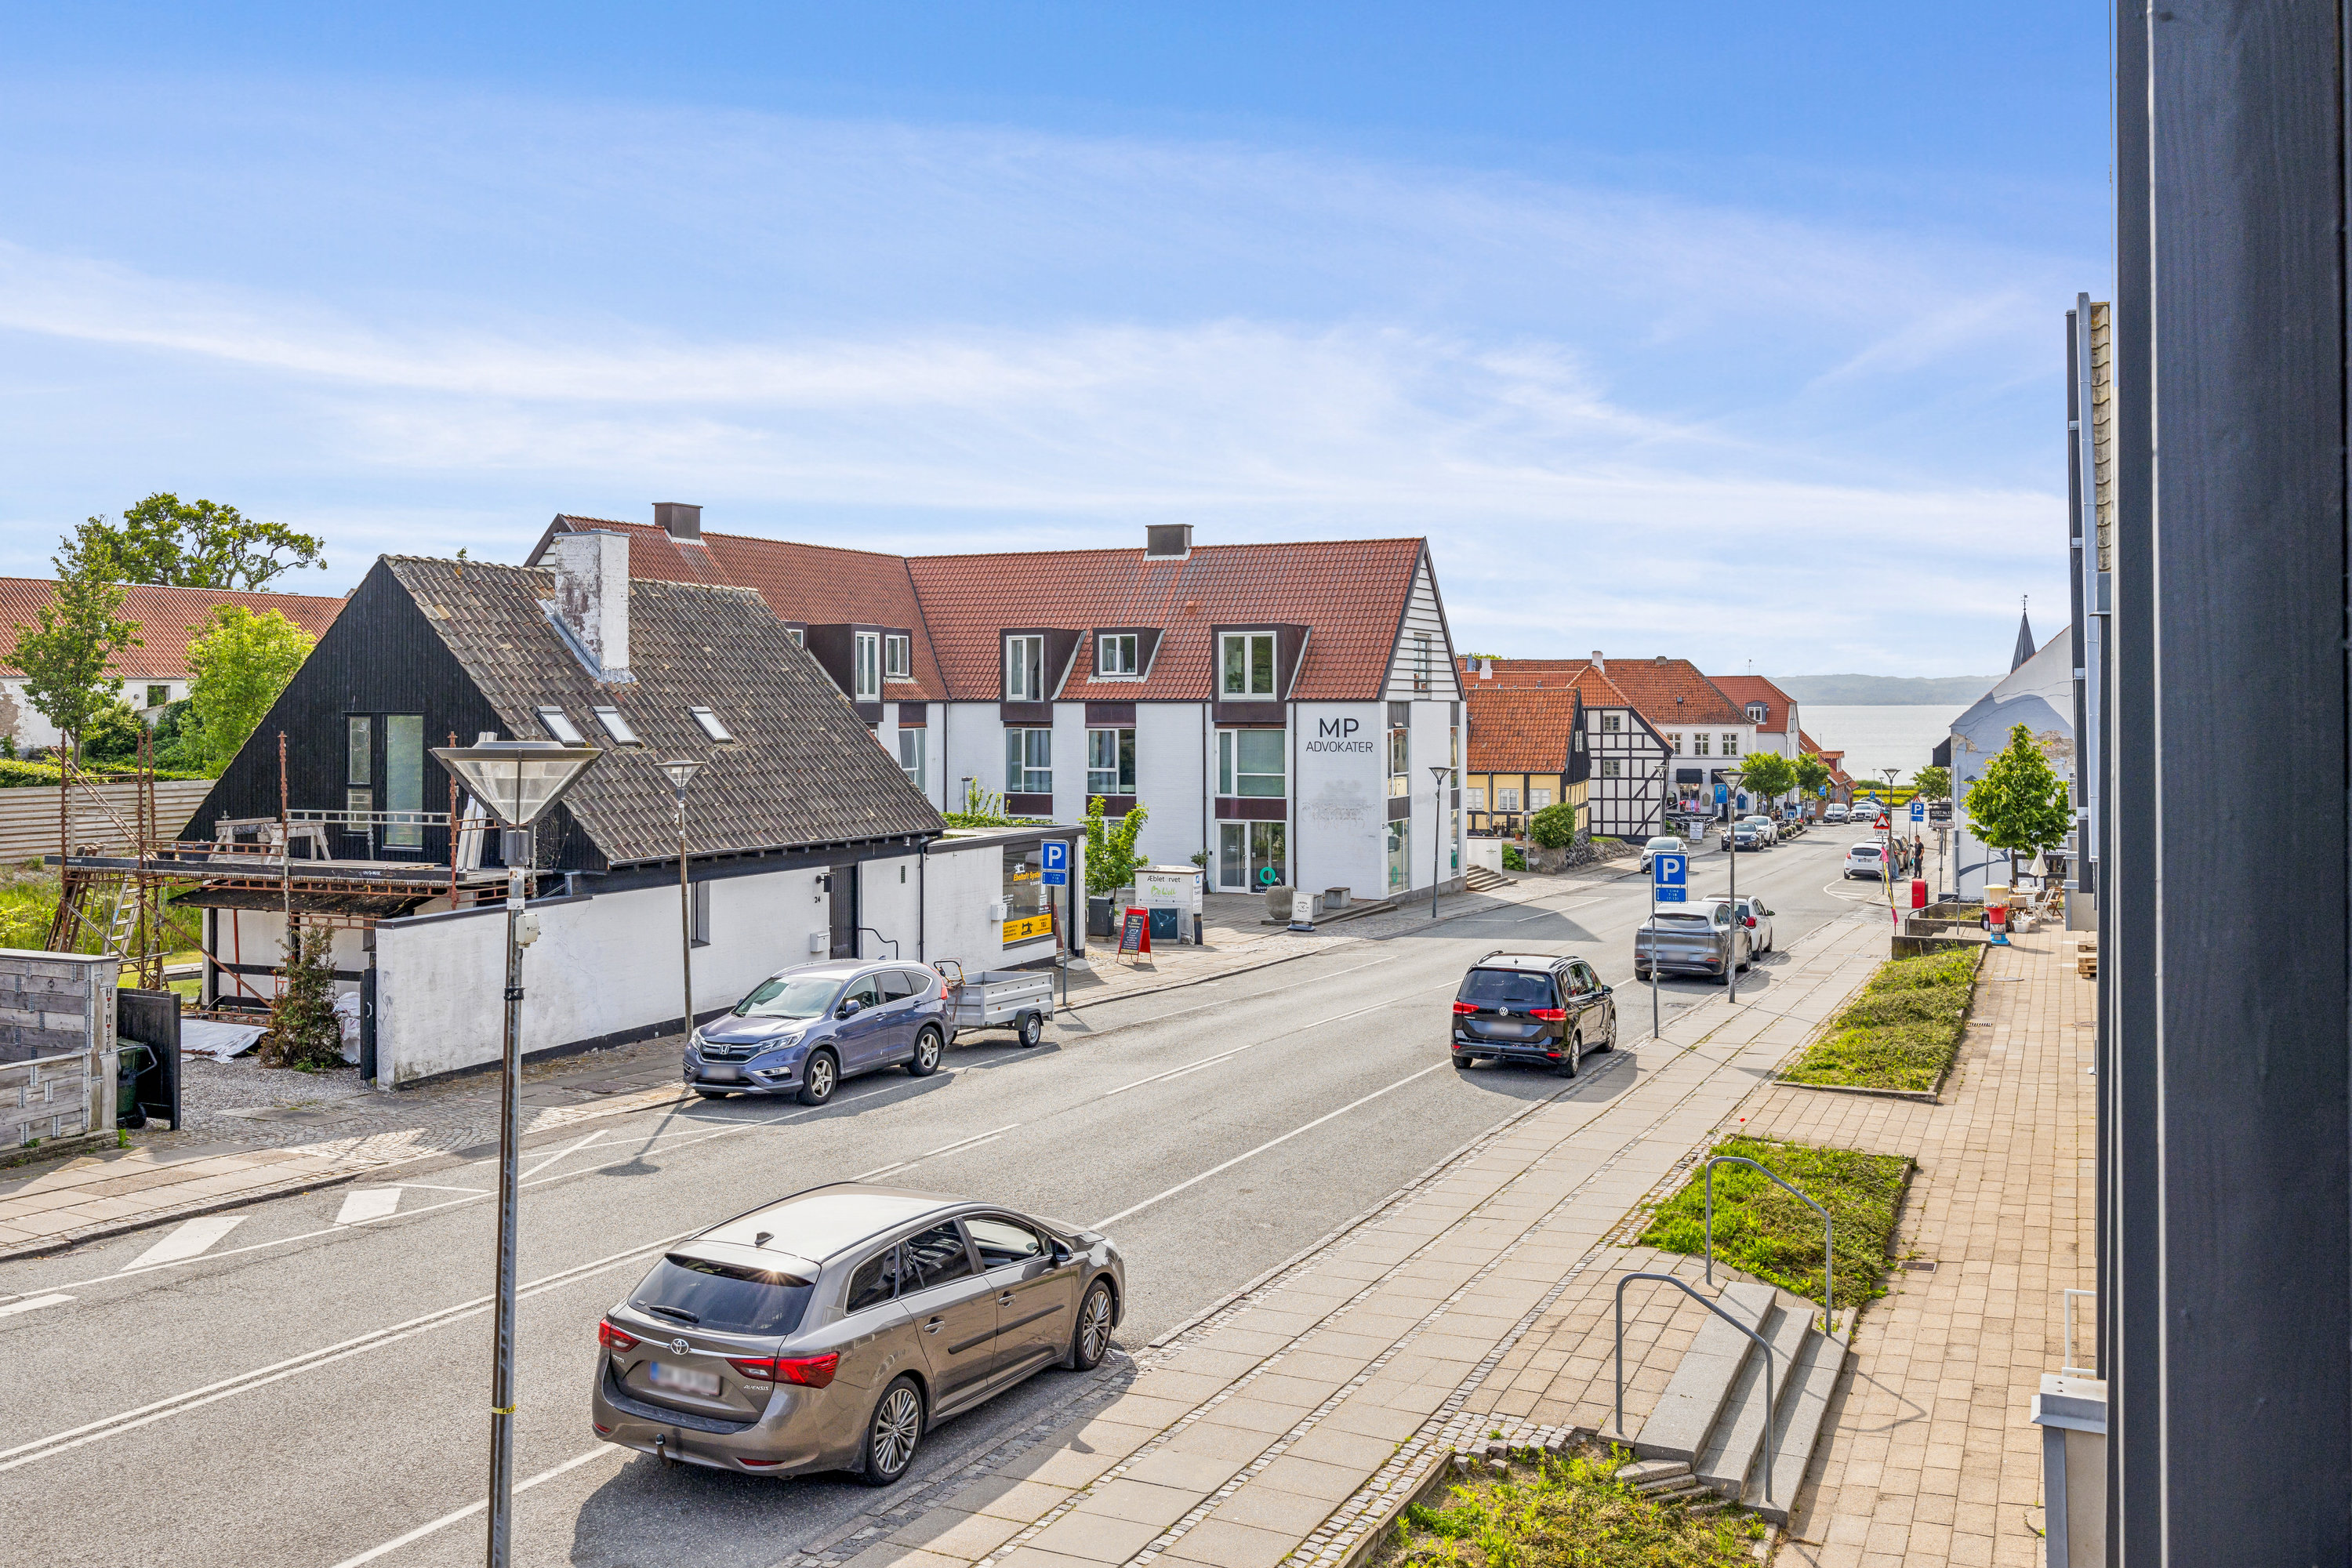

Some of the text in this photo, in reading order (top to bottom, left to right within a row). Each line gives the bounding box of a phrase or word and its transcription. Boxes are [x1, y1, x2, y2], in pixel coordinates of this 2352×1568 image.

[1319, 717, 1359, 738] MP
[1305, 741, 1374, 753] ADVOKATER
[1914, 804, 1922, 814] P
[1048, 846, 1062, 867] P
[1013, 872, 1029, 882] Ebeltoft
[1663, 858, 1680, 881] P
